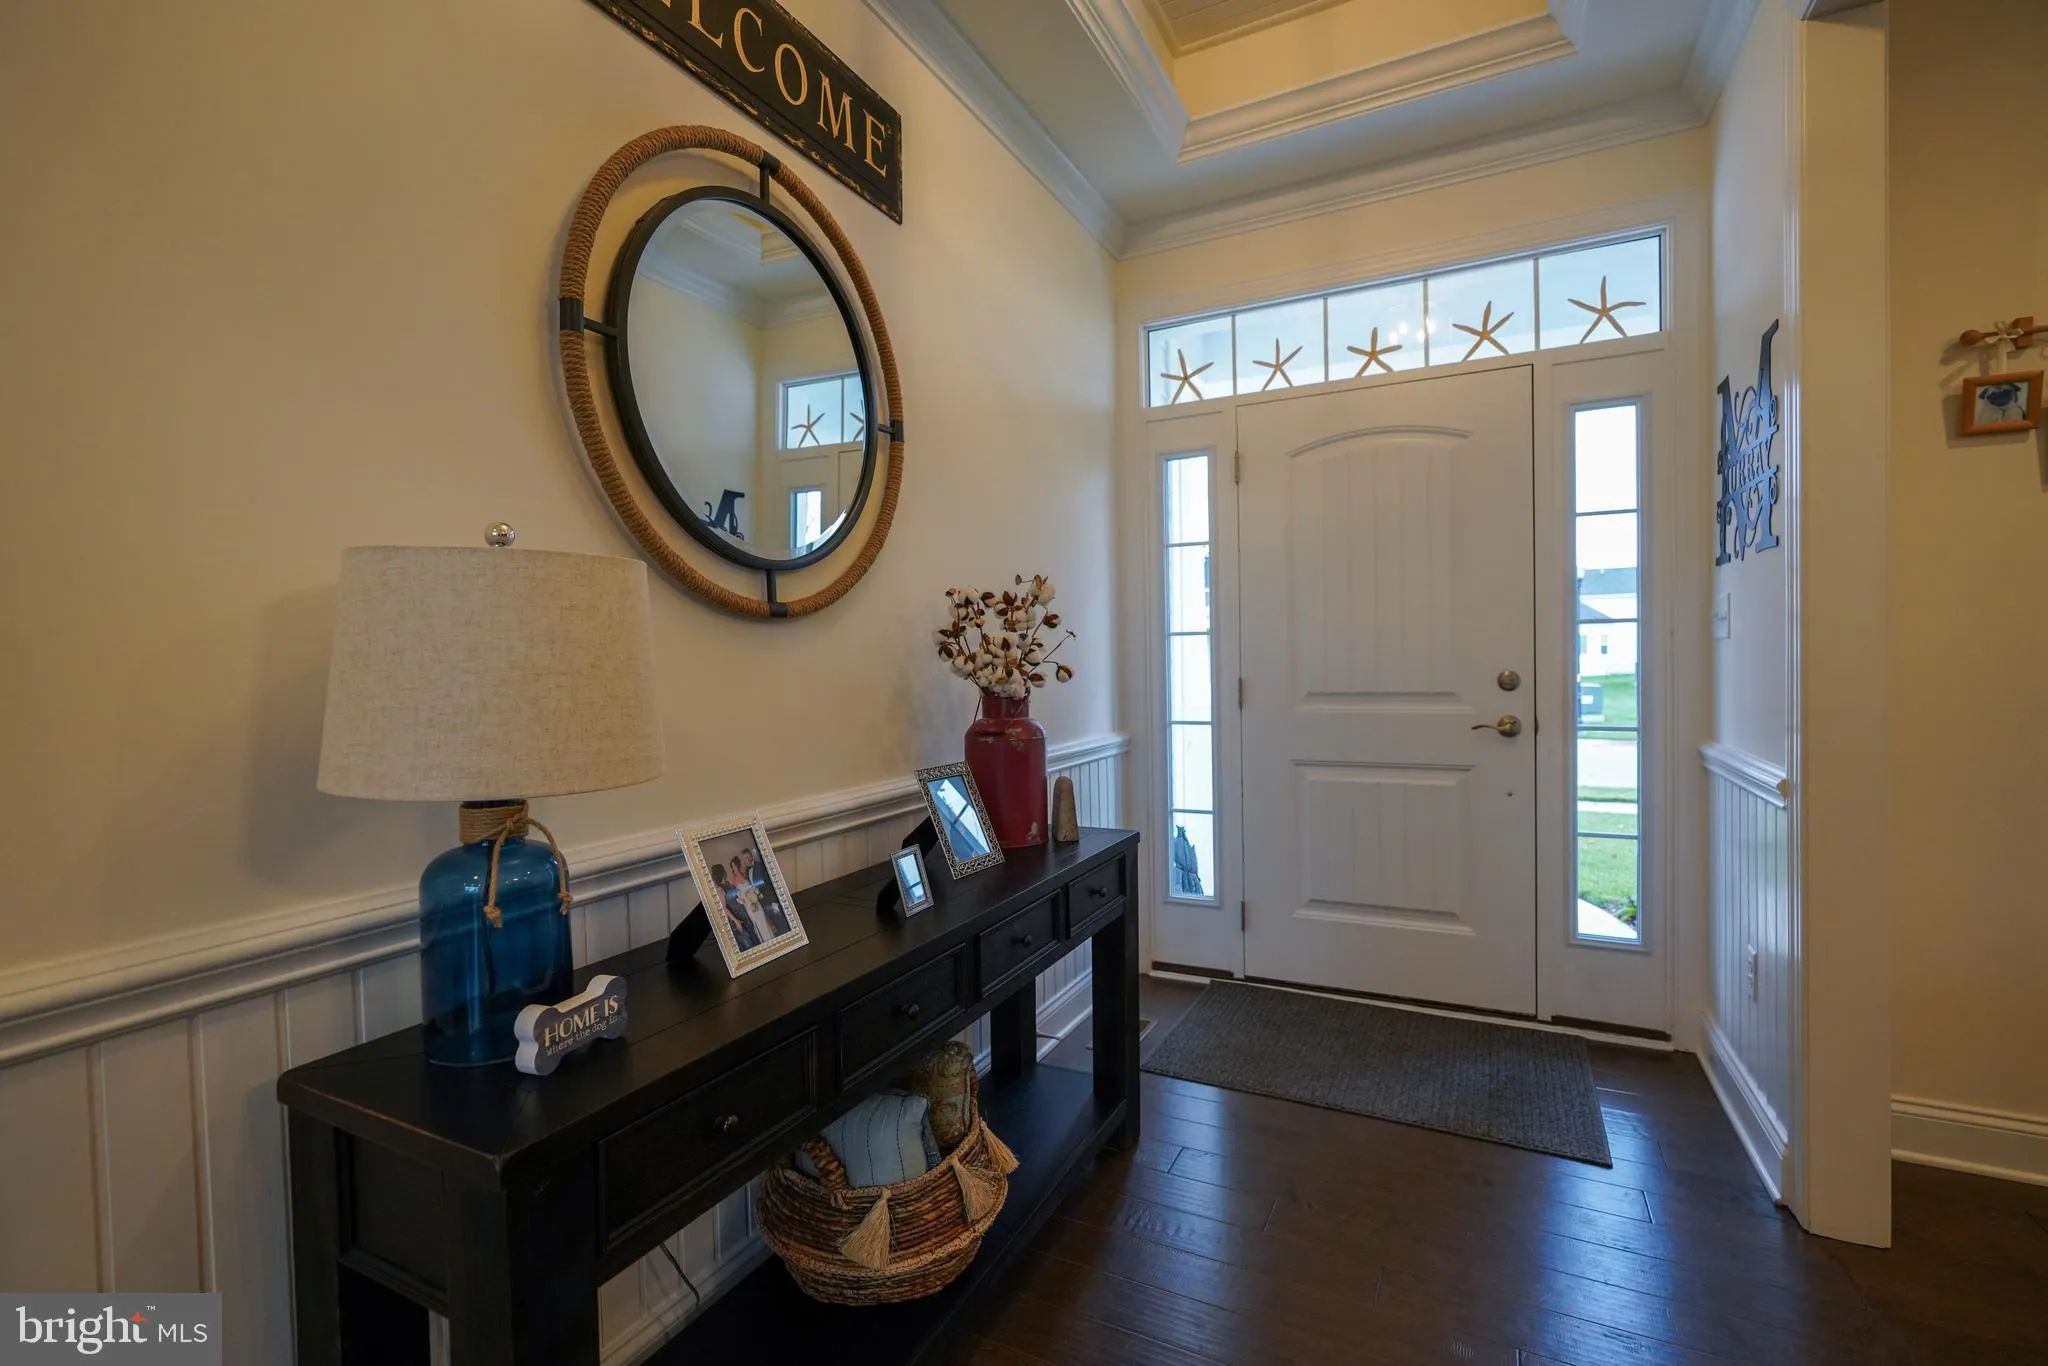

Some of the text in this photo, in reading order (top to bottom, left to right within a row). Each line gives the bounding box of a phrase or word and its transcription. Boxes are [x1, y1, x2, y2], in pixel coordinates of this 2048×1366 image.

[662, 0, 888, 178] LCOME
[1721, 437, 1773, 499] MURRAY
[544, 995, 618, 1047] HOME IS
[546, 1037, 575, 1057] where
[575, 1028, 591, 1041] the
[592, 1019, 608, 1032] dog
